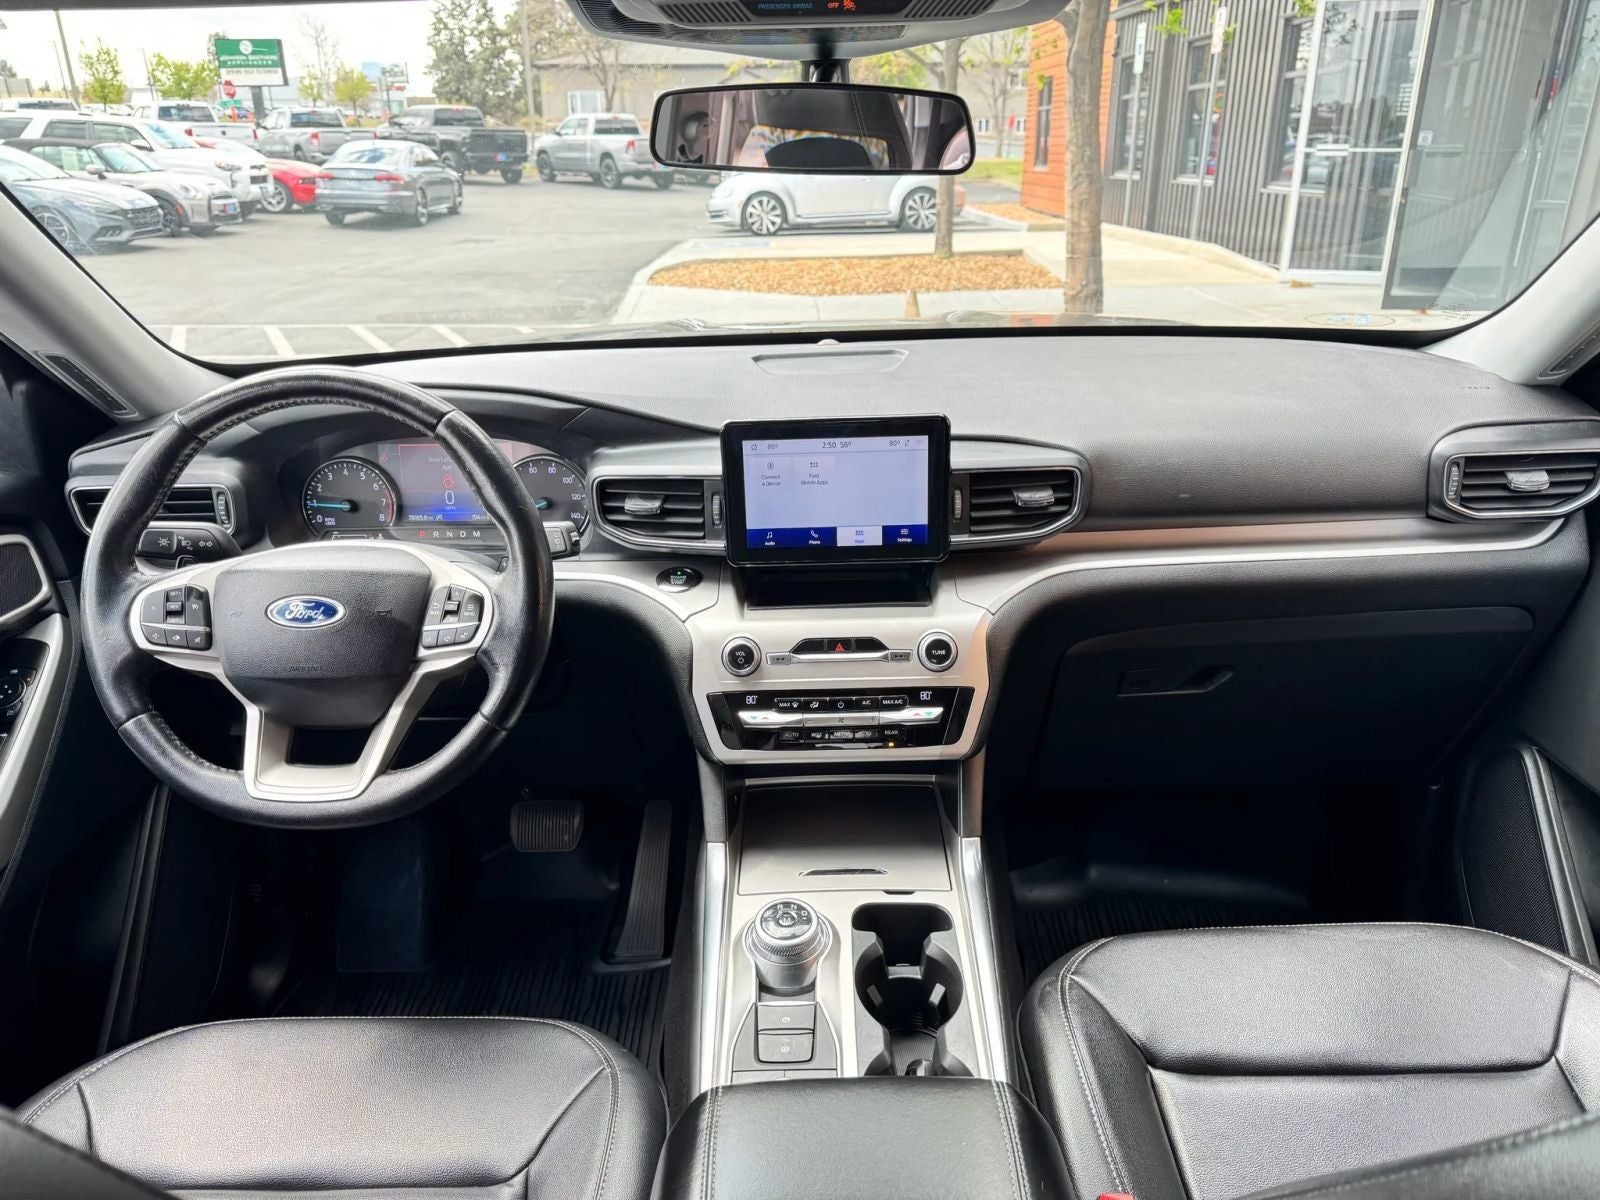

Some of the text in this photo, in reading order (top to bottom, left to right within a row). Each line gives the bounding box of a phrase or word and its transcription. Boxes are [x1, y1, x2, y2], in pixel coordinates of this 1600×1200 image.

[343, 468, 349, 476] 4
[360, 472, 366, 480] 5
[327, 472, 333, 481] 3
[316, 483, 322, 492] 2
[373, 483, 379, 491] 6
[445, 490, 455, 505] 0
[380, 498, 386, 506] 7
[316, 514, 323, 523] 0
[379, 514, 385, 522] 8
[285, 602, 325, 620] Ford
